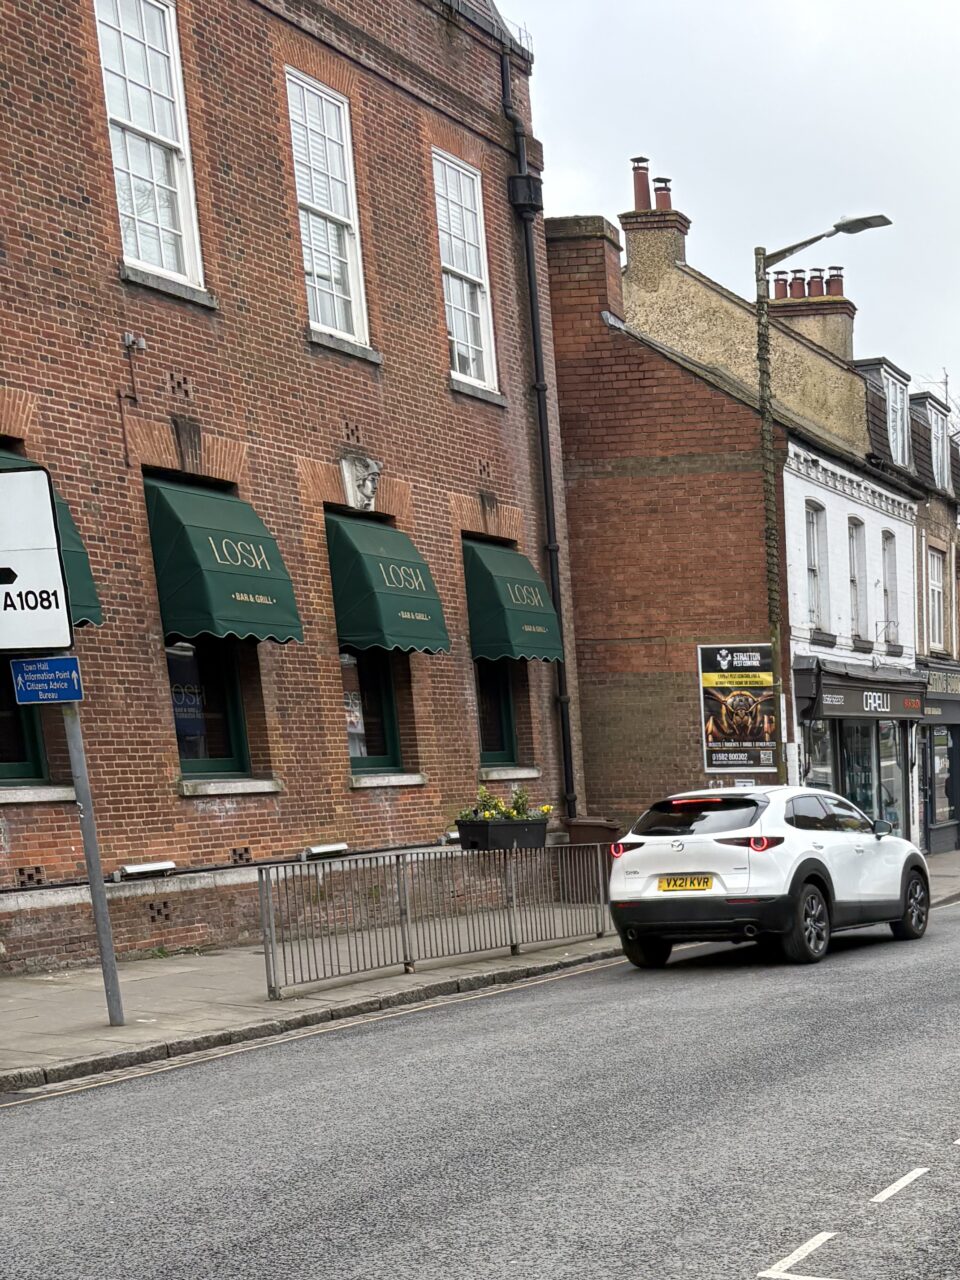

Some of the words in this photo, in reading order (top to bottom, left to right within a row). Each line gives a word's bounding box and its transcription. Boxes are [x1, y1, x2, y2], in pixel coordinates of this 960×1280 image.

[208, 536, 271, 571] LOSH
[379, 562, 426, 591] LOSH
[3, 590, 60, 611] A1081
[235, 592, 249, 602] BAR
[249, 594, 254, 603] &
[255, 594, 273, 605] GRILL
[507, 583, 544, 607] LOSH
[733, 652, 760, 661] STRATTON
[22, 663, 36, 671] Town
[37, 662, 49, 670] Hall
[24, 672, 55, 680] Information
[55, 671, 70, 679] Point
[26, 681, 48, 690] Citizens
[49, 680, 68, 689] Advice
[38, 691, 58, 699] Bureau
[172, 684, 206, 705] OSH
[665, 877, 688, 888] VX21
[689, 877, 710, 887] KVR
